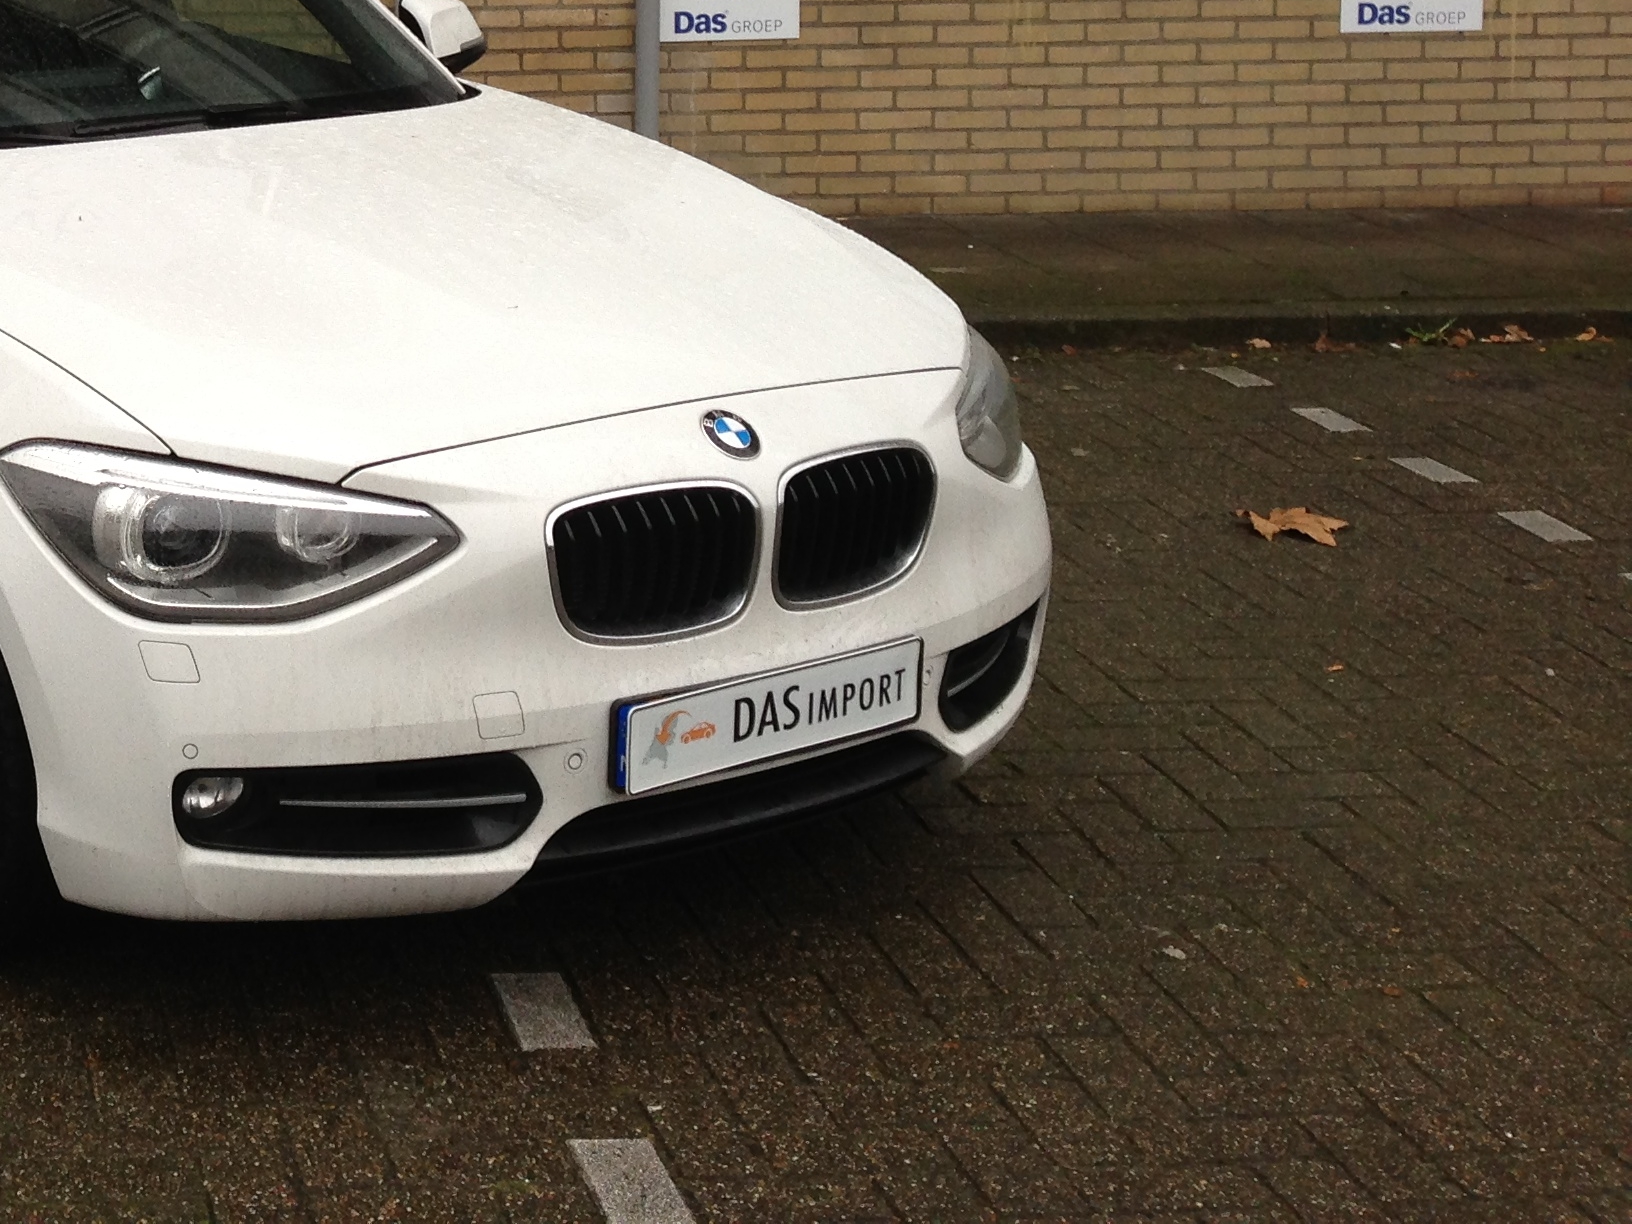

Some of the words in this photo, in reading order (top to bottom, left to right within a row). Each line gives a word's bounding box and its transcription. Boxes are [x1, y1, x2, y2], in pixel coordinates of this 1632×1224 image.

[674, 11, 728, 35] Das
[731, 19, 783, 34] GROEP
[1357, 2, 1411, 26] Das
[1414, 10, 1466, 26] GROEP
